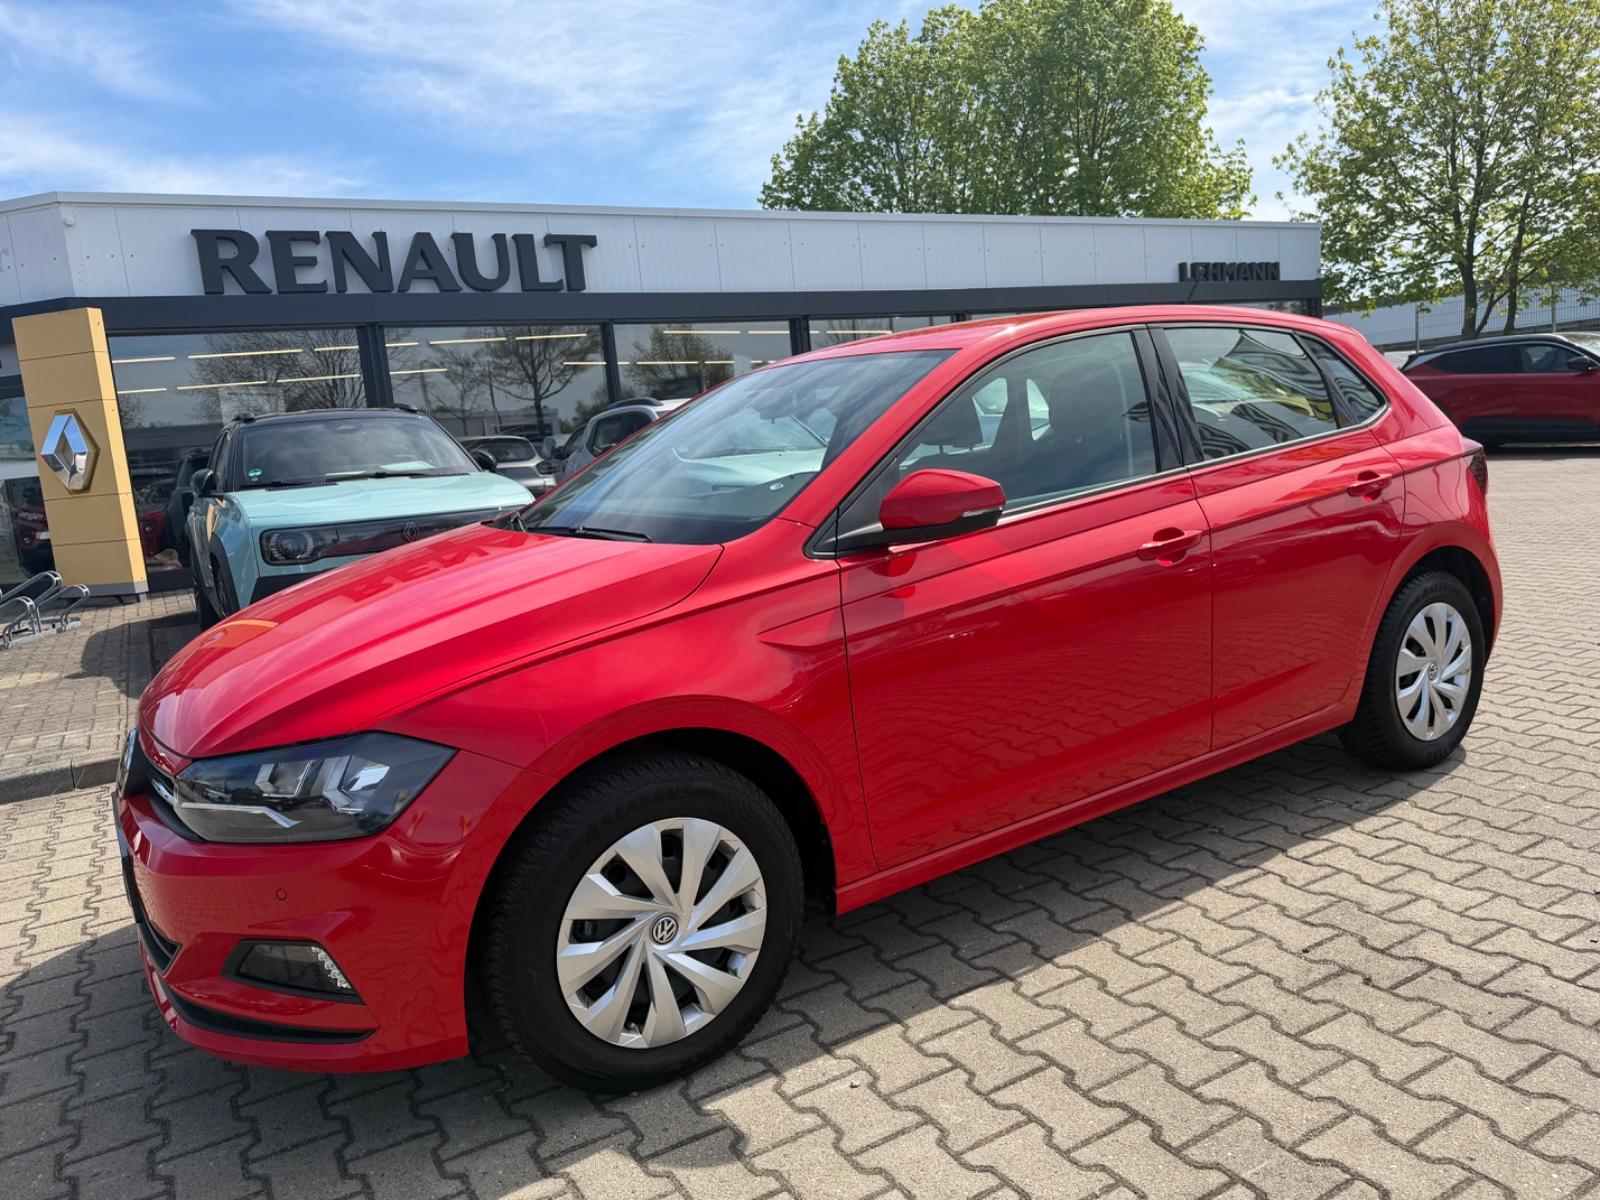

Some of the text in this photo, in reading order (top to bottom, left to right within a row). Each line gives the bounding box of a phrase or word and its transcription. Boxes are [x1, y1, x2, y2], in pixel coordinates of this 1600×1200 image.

[190, 229, 598, 295] RENAULT
[1178, 261, 1280, 282] LEHMANN
[653, 916, 678, 943] VW
